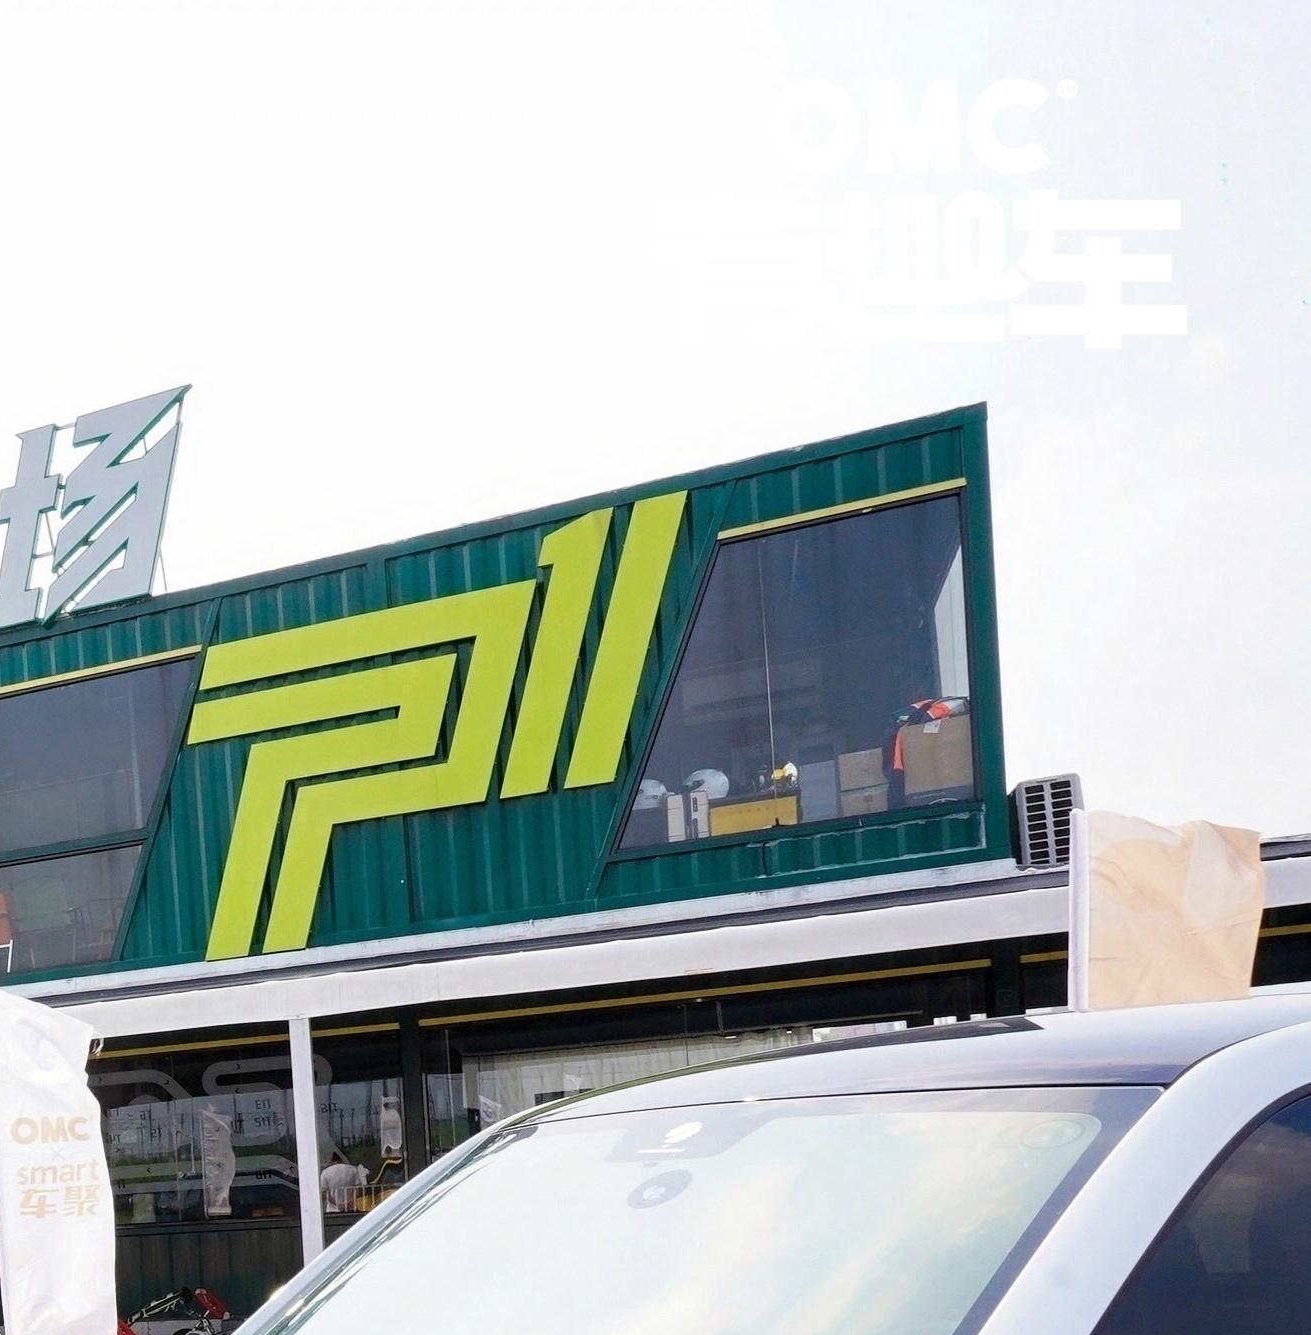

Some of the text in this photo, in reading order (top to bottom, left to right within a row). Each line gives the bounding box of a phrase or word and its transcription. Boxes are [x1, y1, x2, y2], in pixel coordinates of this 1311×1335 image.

[10, 1115, 92, 1144] OMC
[17, 1157, 100, 1186] smart
[19, 1185, 101, 1219] 车聚
